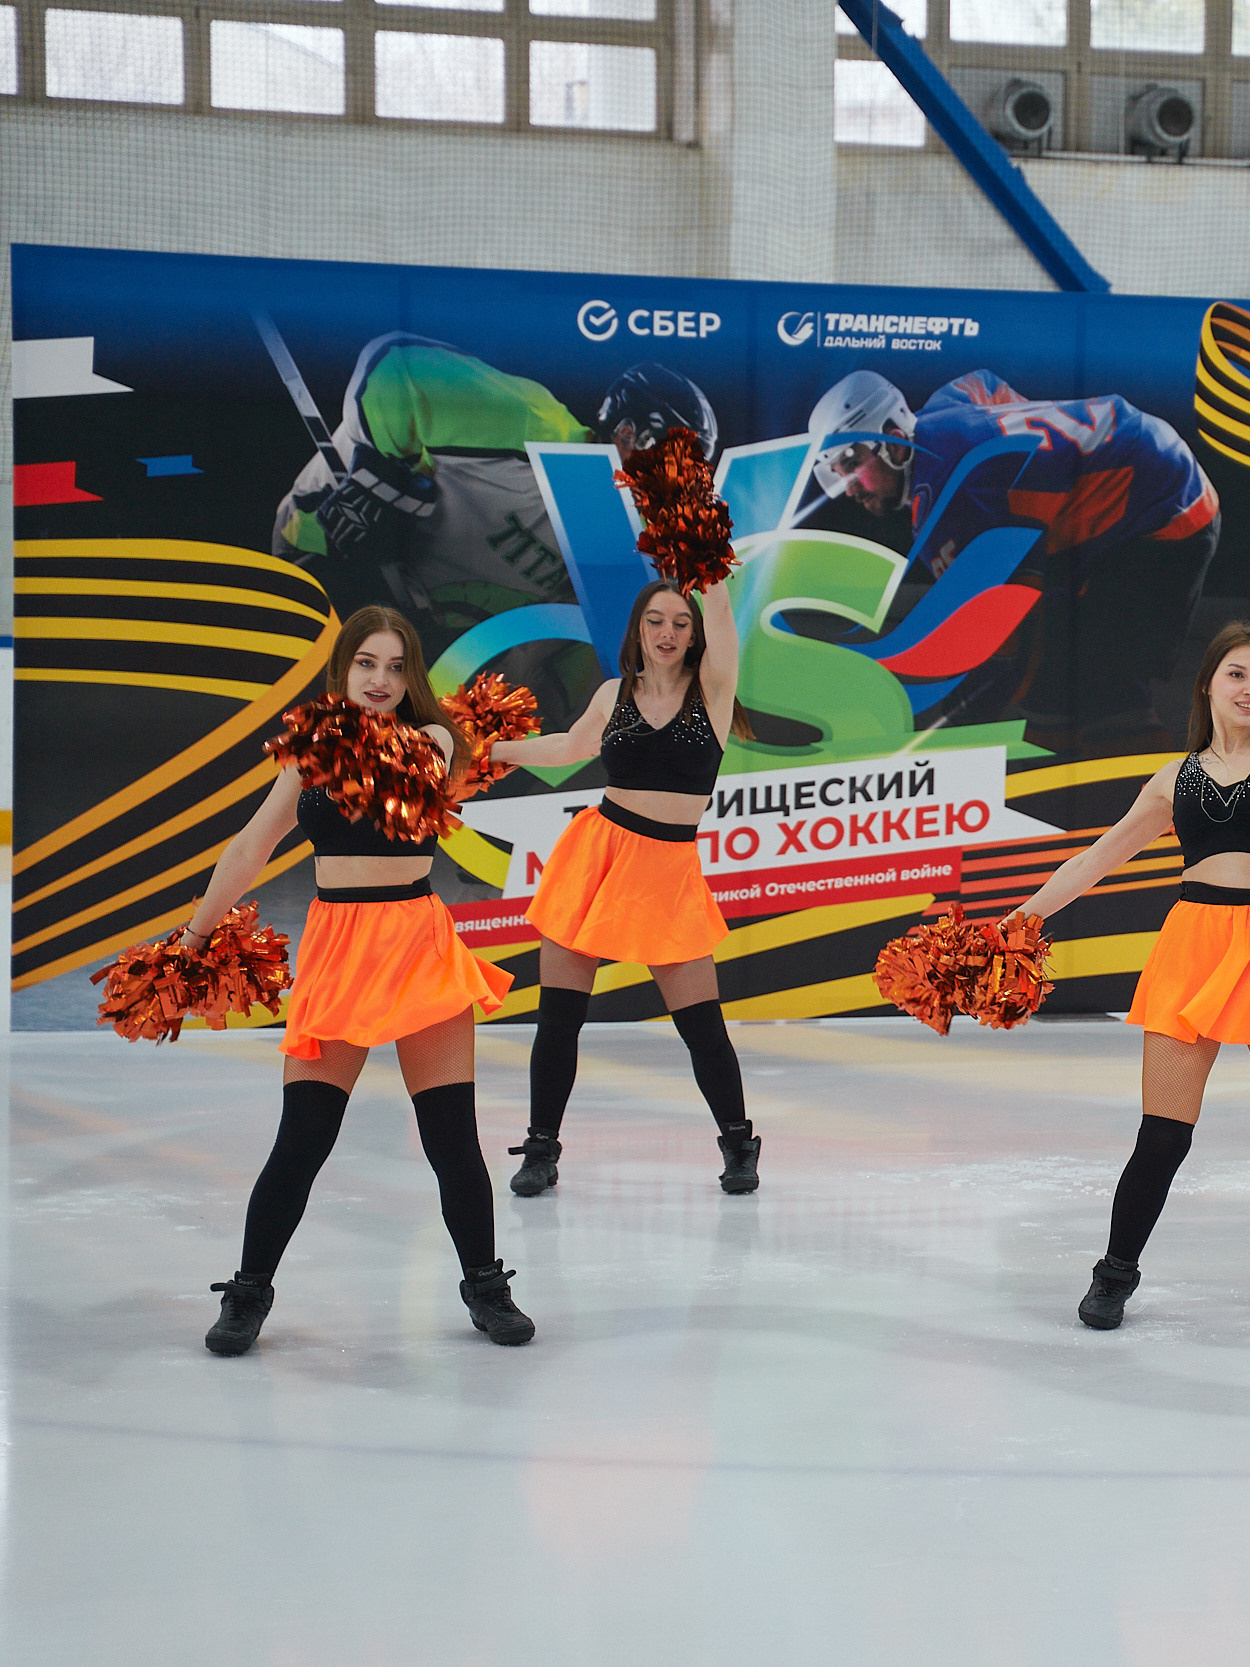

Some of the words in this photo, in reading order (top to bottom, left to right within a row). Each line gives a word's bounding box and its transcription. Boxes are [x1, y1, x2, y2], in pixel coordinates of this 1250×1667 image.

[627, 309, 721, 338] СБЕР
[823, 312, 980, 337] ТРАНСНЕФТЬ
[823, 334, 886, 349] ДАЛЬНИЙ
[891, 338, 942, 351] ВОСТОК
[563, 759, 936, 819] ИЩЕСКИЙ
[775, 799, 991, 856] ХОККЕЮ
[765, 869, 897, 897] Отечественной
[900, 863, 952, 881] войне
